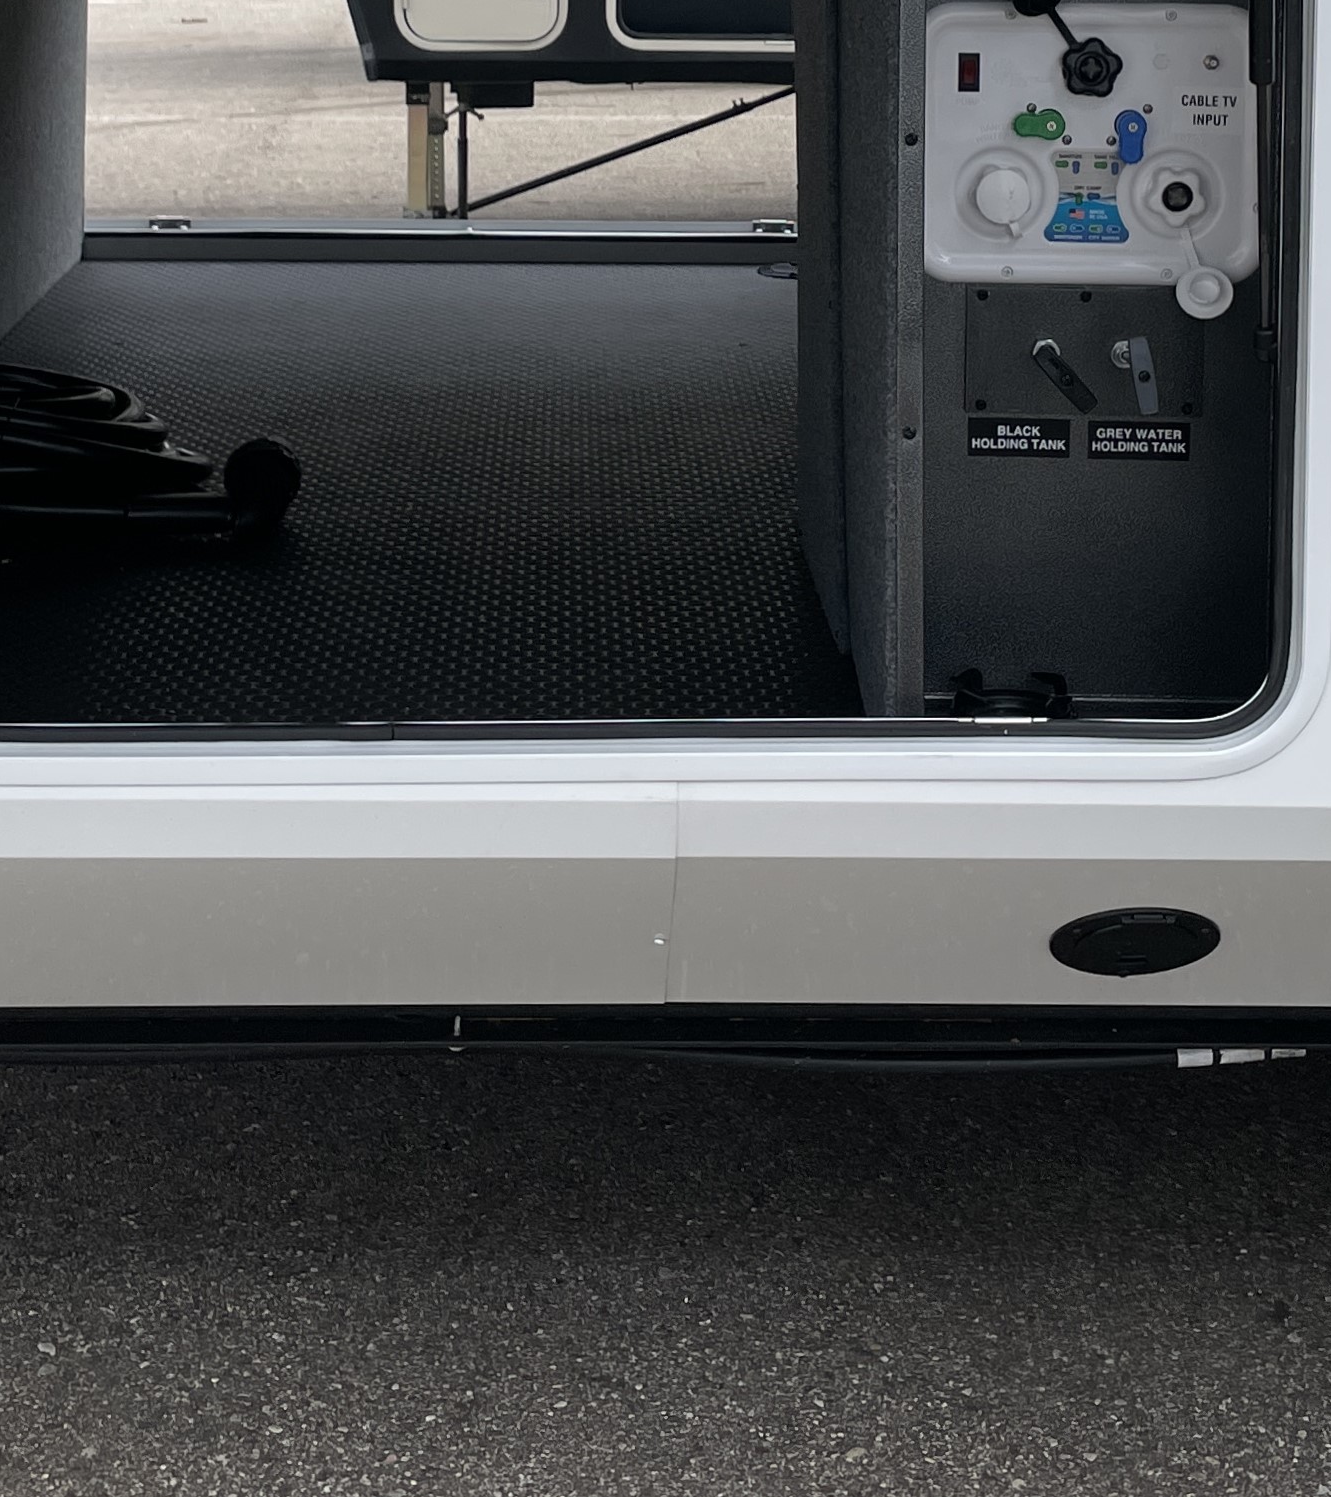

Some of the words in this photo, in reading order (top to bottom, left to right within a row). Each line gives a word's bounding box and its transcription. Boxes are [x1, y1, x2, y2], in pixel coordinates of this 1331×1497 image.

[1181, 94, 1219, 108] CABLE
[1221, 95, 1238, 109] TV
[1192, 113, 1229, 127] INPUT
[996, 424, 1041, 438] BLACK
[1096, 427, 1132, 440] GREY
[1135, 428, 1182, 441] WATER
[971, 437, 1029, 450] HOLDING
[1032, 438, 1067, 451] TANK
[1091, 440, 1150, 453] HOLDING
[1152, 441, 1187, 454] TANK
